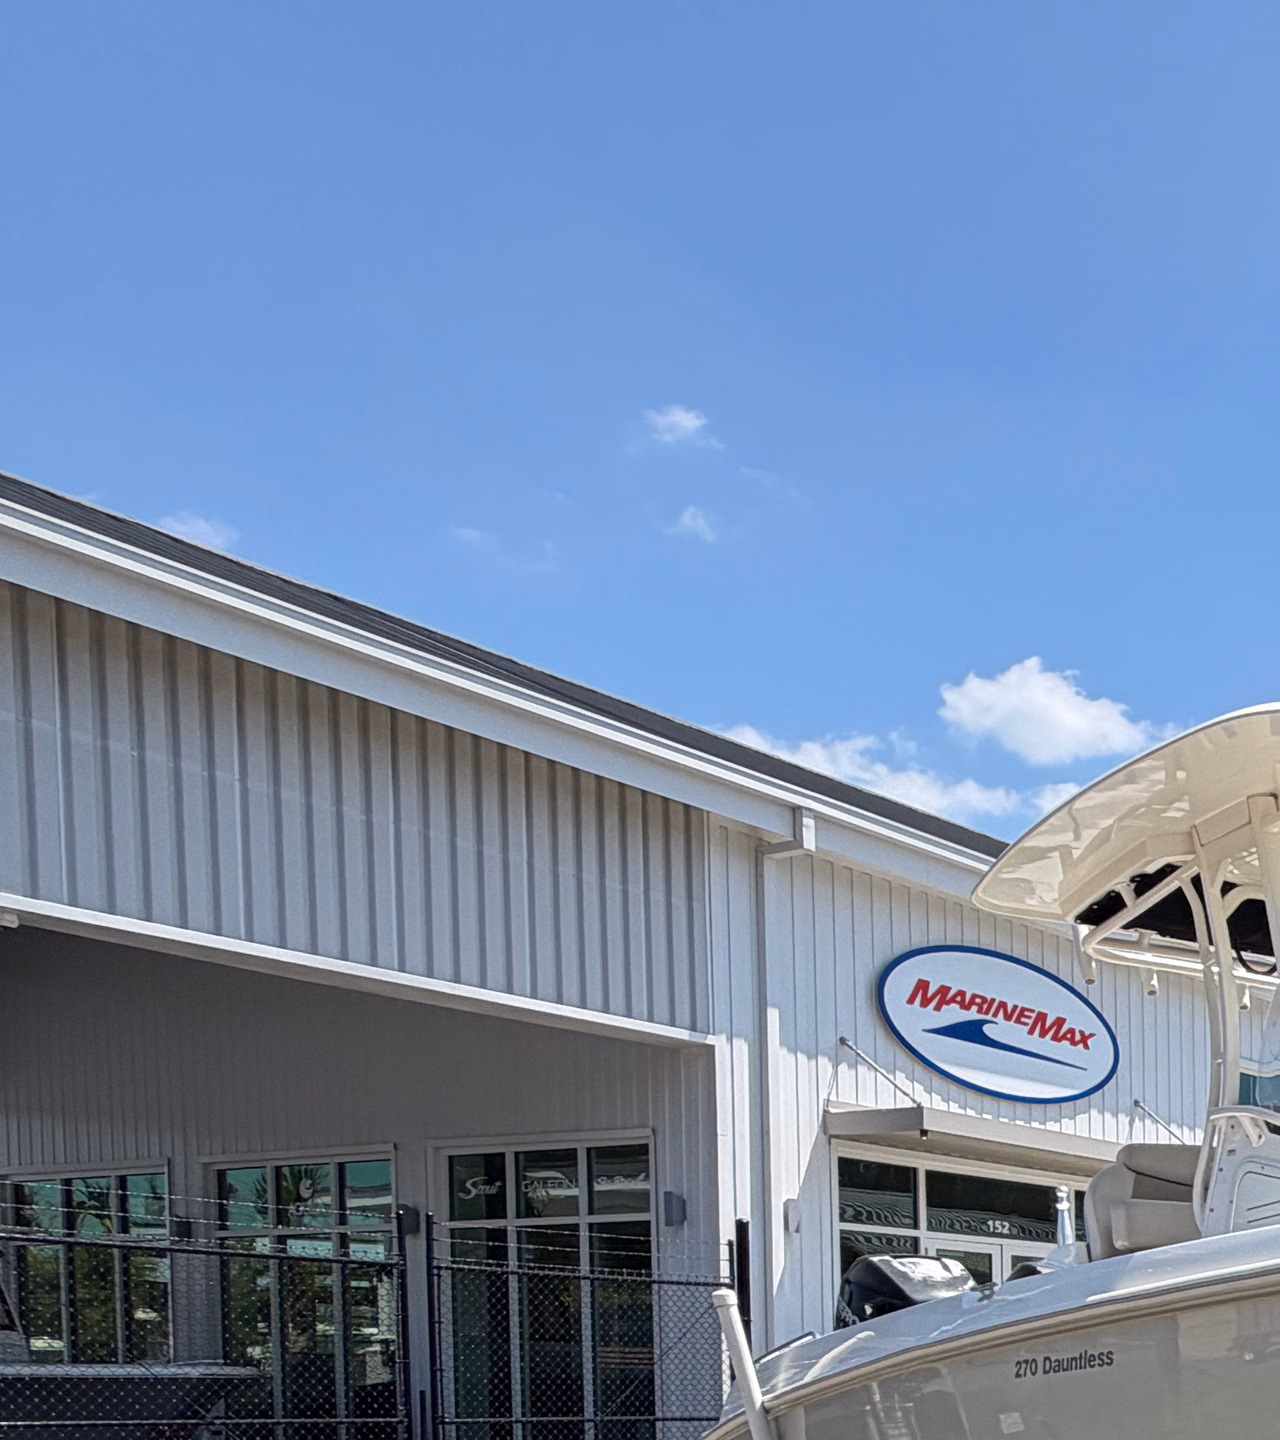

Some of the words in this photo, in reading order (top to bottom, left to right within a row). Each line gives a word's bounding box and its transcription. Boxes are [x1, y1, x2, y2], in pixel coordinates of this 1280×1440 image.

[906, 978, 1096, 1050] MARINEMAX
[457, 1176, 503, 1199] Scout
[987, 1220, 1010, 1234] 152
[1015, 1358, 1038, 1379] 270
[1043, 1350, 1114, 1375] Dauntless
